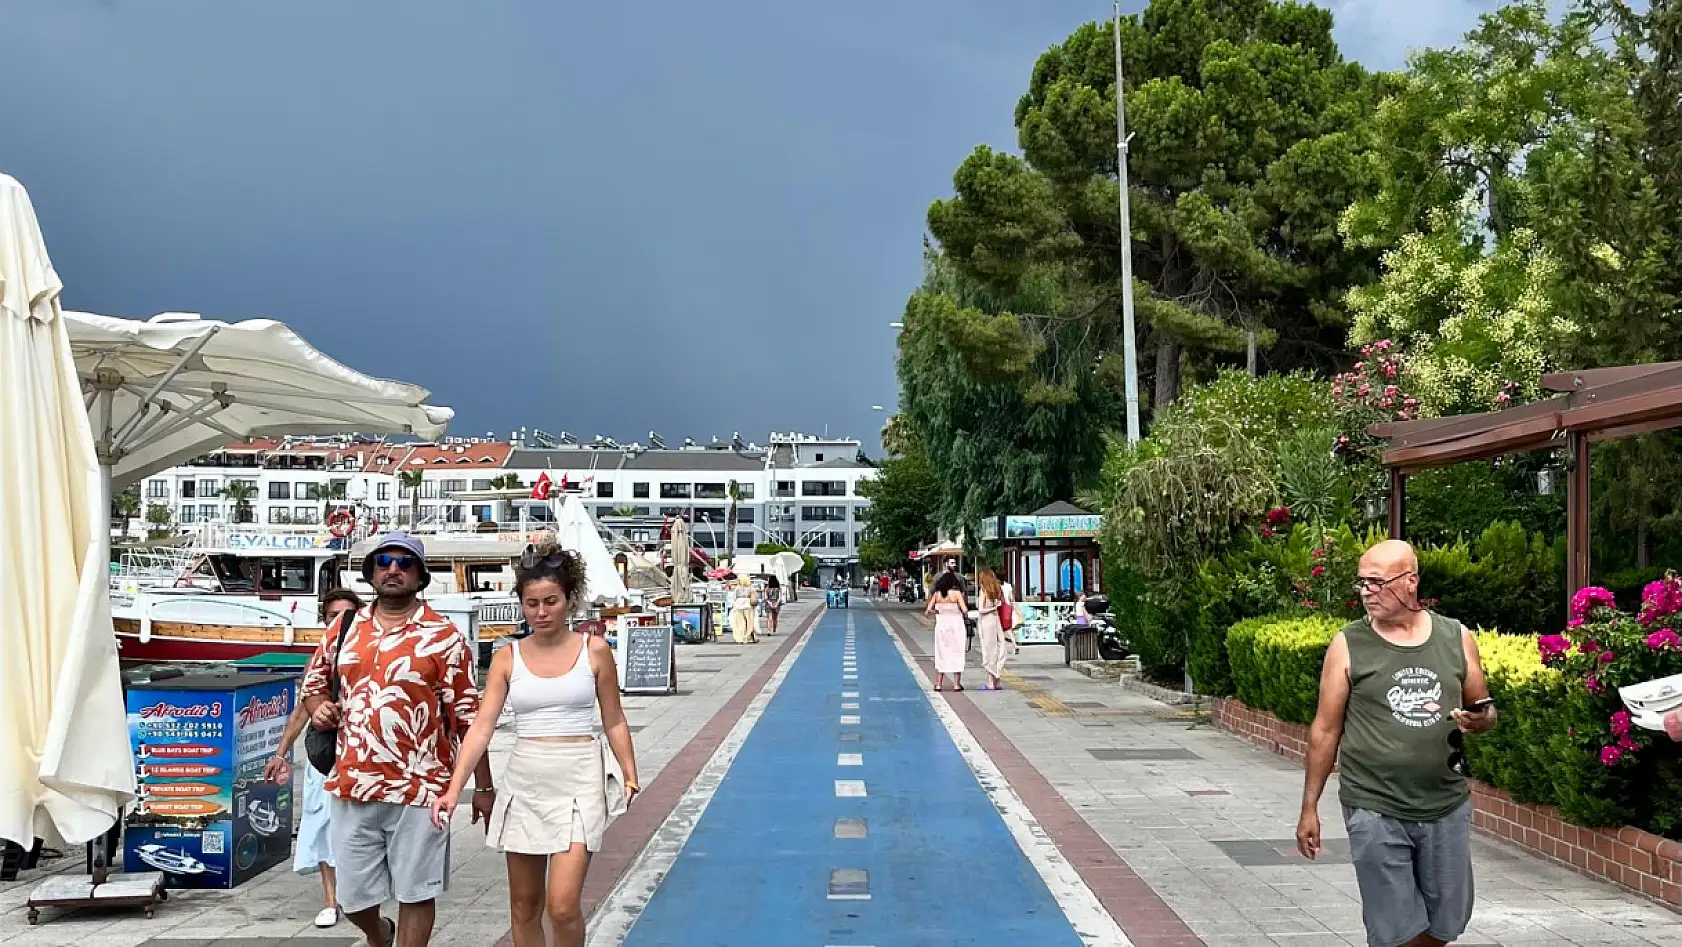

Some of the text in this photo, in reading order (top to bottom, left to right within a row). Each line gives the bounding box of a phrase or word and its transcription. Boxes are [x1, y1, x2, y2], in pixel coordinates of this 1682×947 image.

[1387, 682, 1442, 704] Original
[140, 702, 222, 718] Afrodit 3
